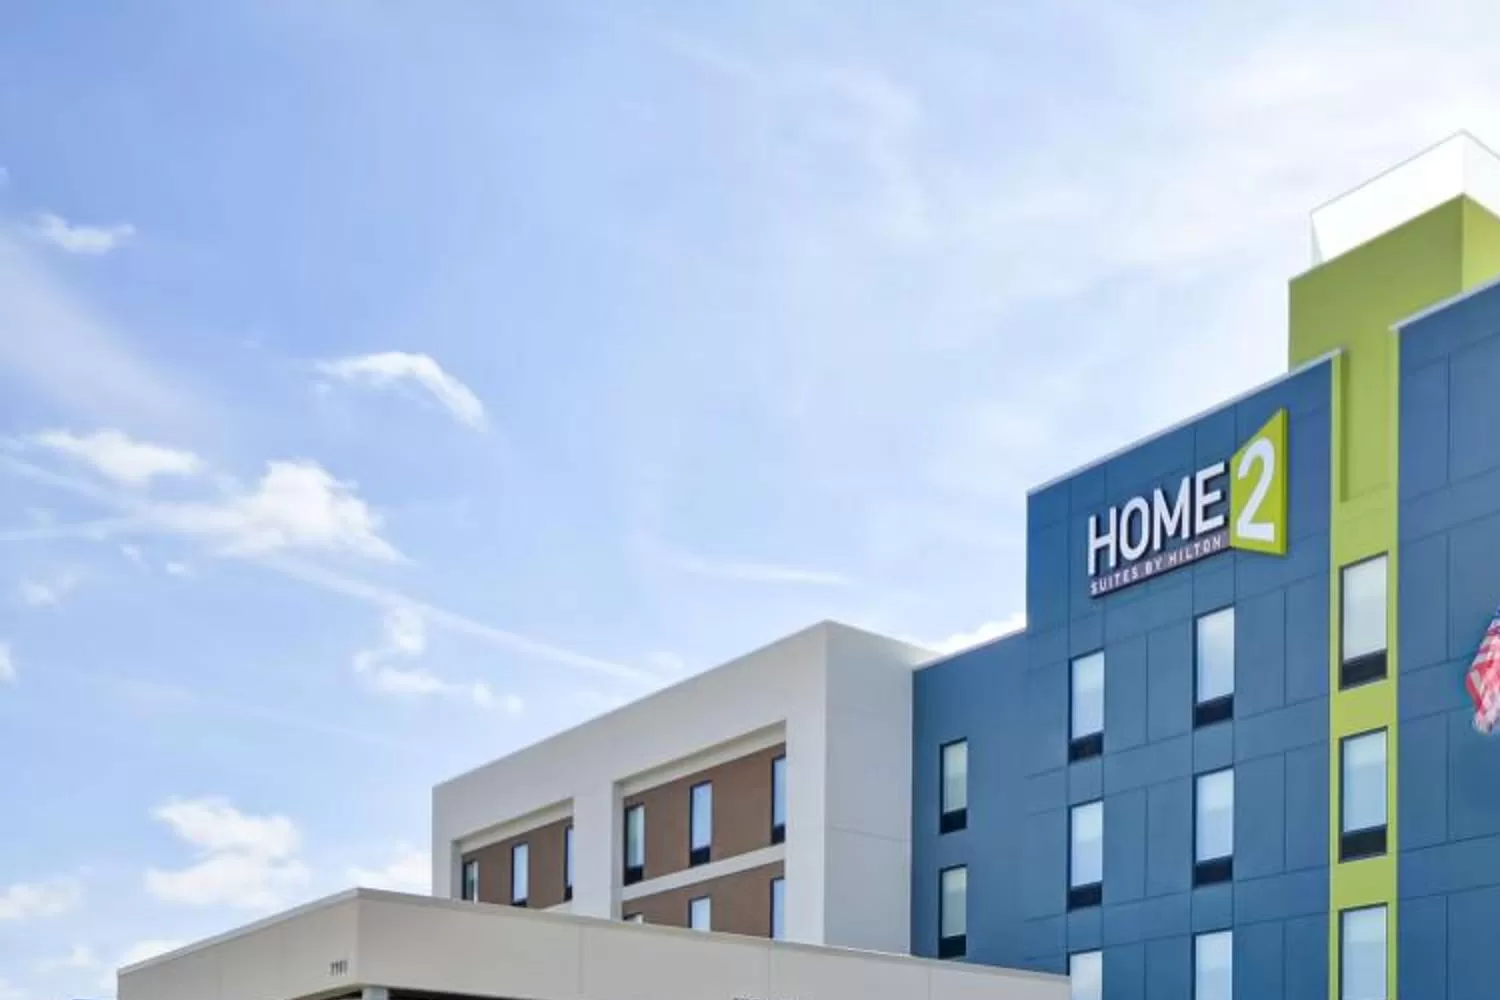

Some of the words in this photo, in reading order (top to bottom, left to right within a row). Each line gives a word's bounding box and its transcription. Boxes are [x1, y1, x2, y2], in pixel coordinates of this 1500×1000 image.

[1088, 461, 1225, 576] HOME
[1237, 437, 1276, 544] 2
[1090, 569, 1138, 596] SUITES
[1145, 556, 1163, 575] BY
[1168, 535, 1222, 566] HILTON
